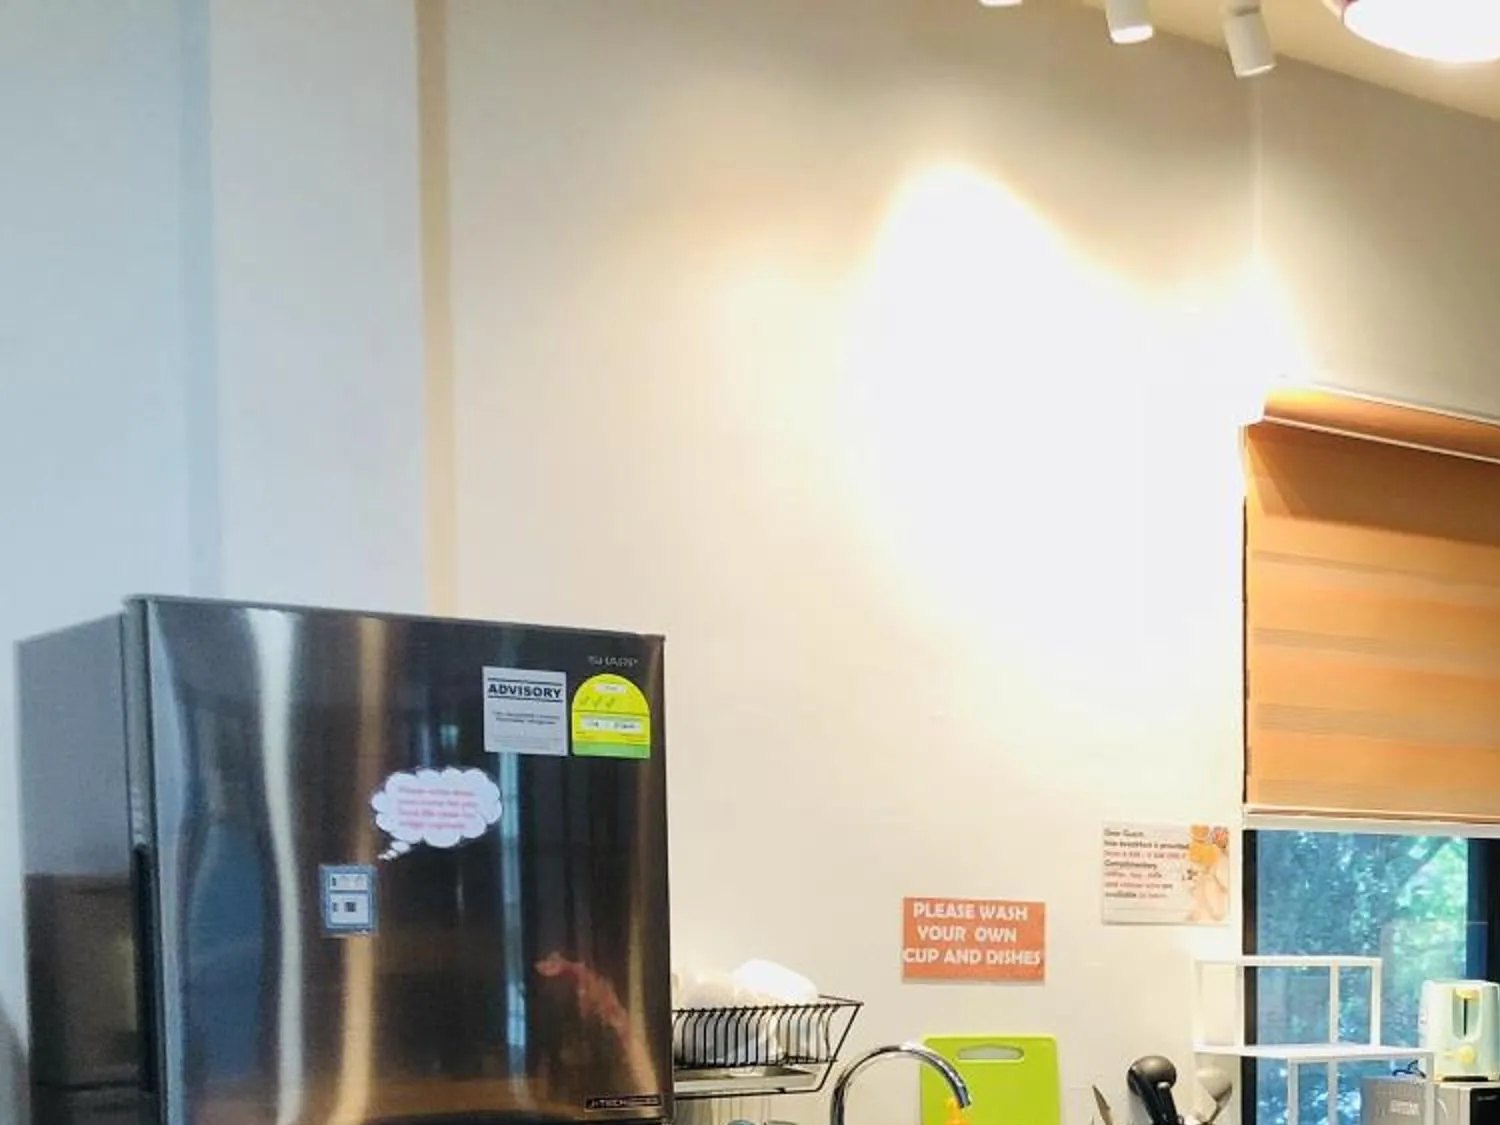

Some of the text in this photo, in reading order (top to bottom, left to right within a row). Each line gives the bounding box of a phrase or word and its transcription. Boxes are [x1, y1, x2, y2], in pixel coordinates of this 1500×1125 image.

[487, 683, 562, 699] ADVISORY
[913, 901, 1029, 921] PLEASE WASH
[917, 925, 1018, 943] YOUR OWN
[903, 947, 1041, 966] CUP AND DISHES
